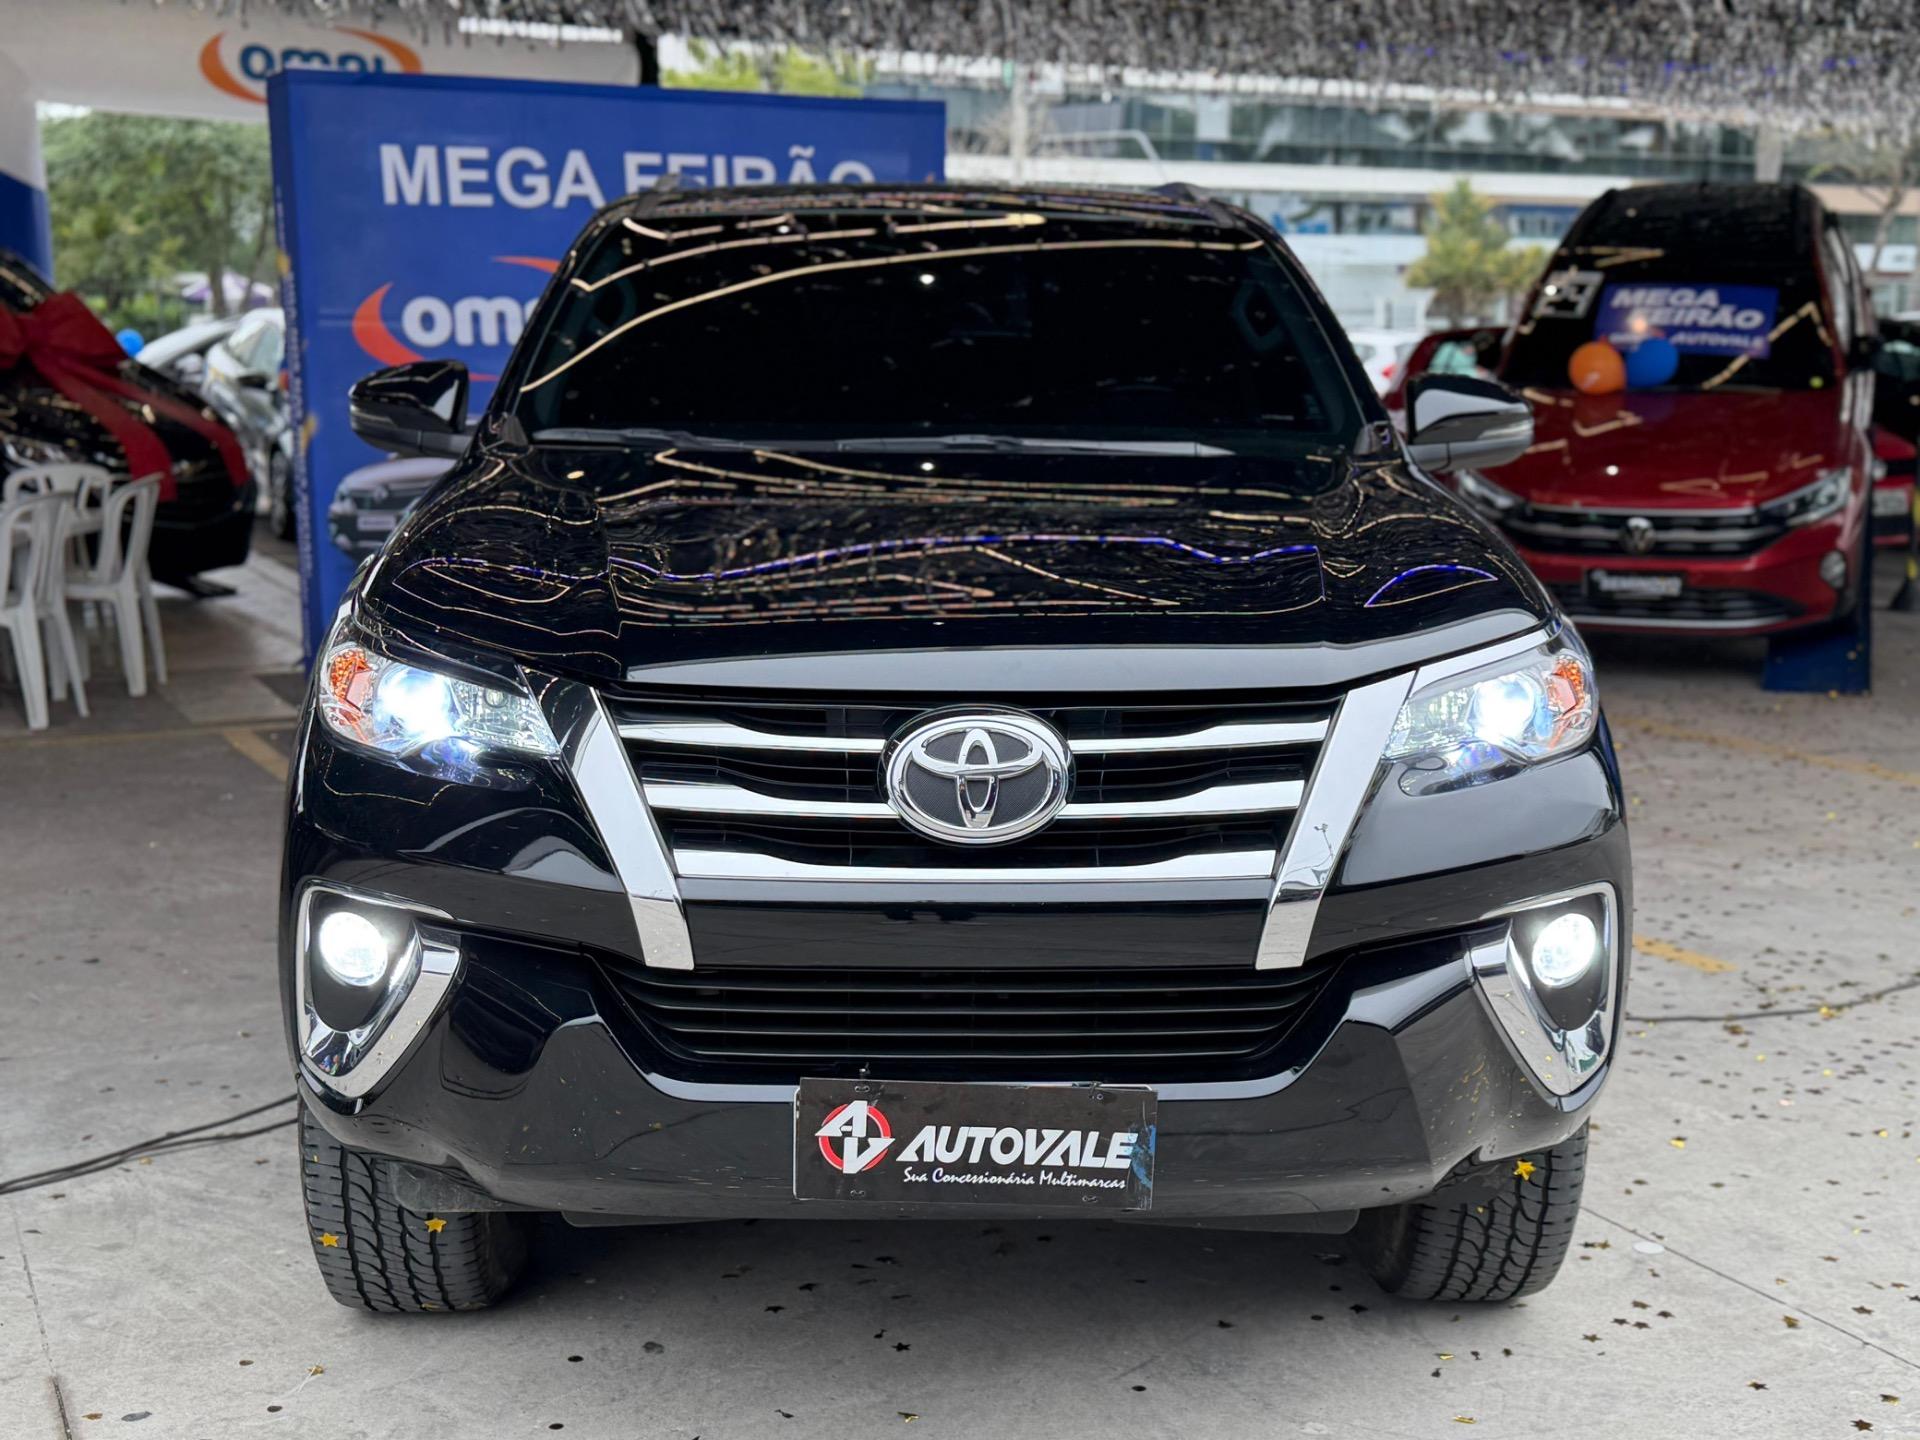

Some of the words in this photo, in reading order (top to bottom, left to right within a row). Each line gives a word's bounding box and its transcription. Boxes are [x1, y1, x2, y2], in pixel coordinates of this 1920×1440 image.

[380, 143, 606, 209] MEGA
[1611, 287, 1720, 308] MEGA
[402, 294, 542, 349] om
[1669, 330, 1764, 349] AUTOVALE
[896, 1125, 1139, 1169] AUTOVALE
[903, 1166, 929, 1183] Sua
[932, 1166, 1036, 1186] Concessionária
[1038, 1169, 1126, 1190] Multimarcas
